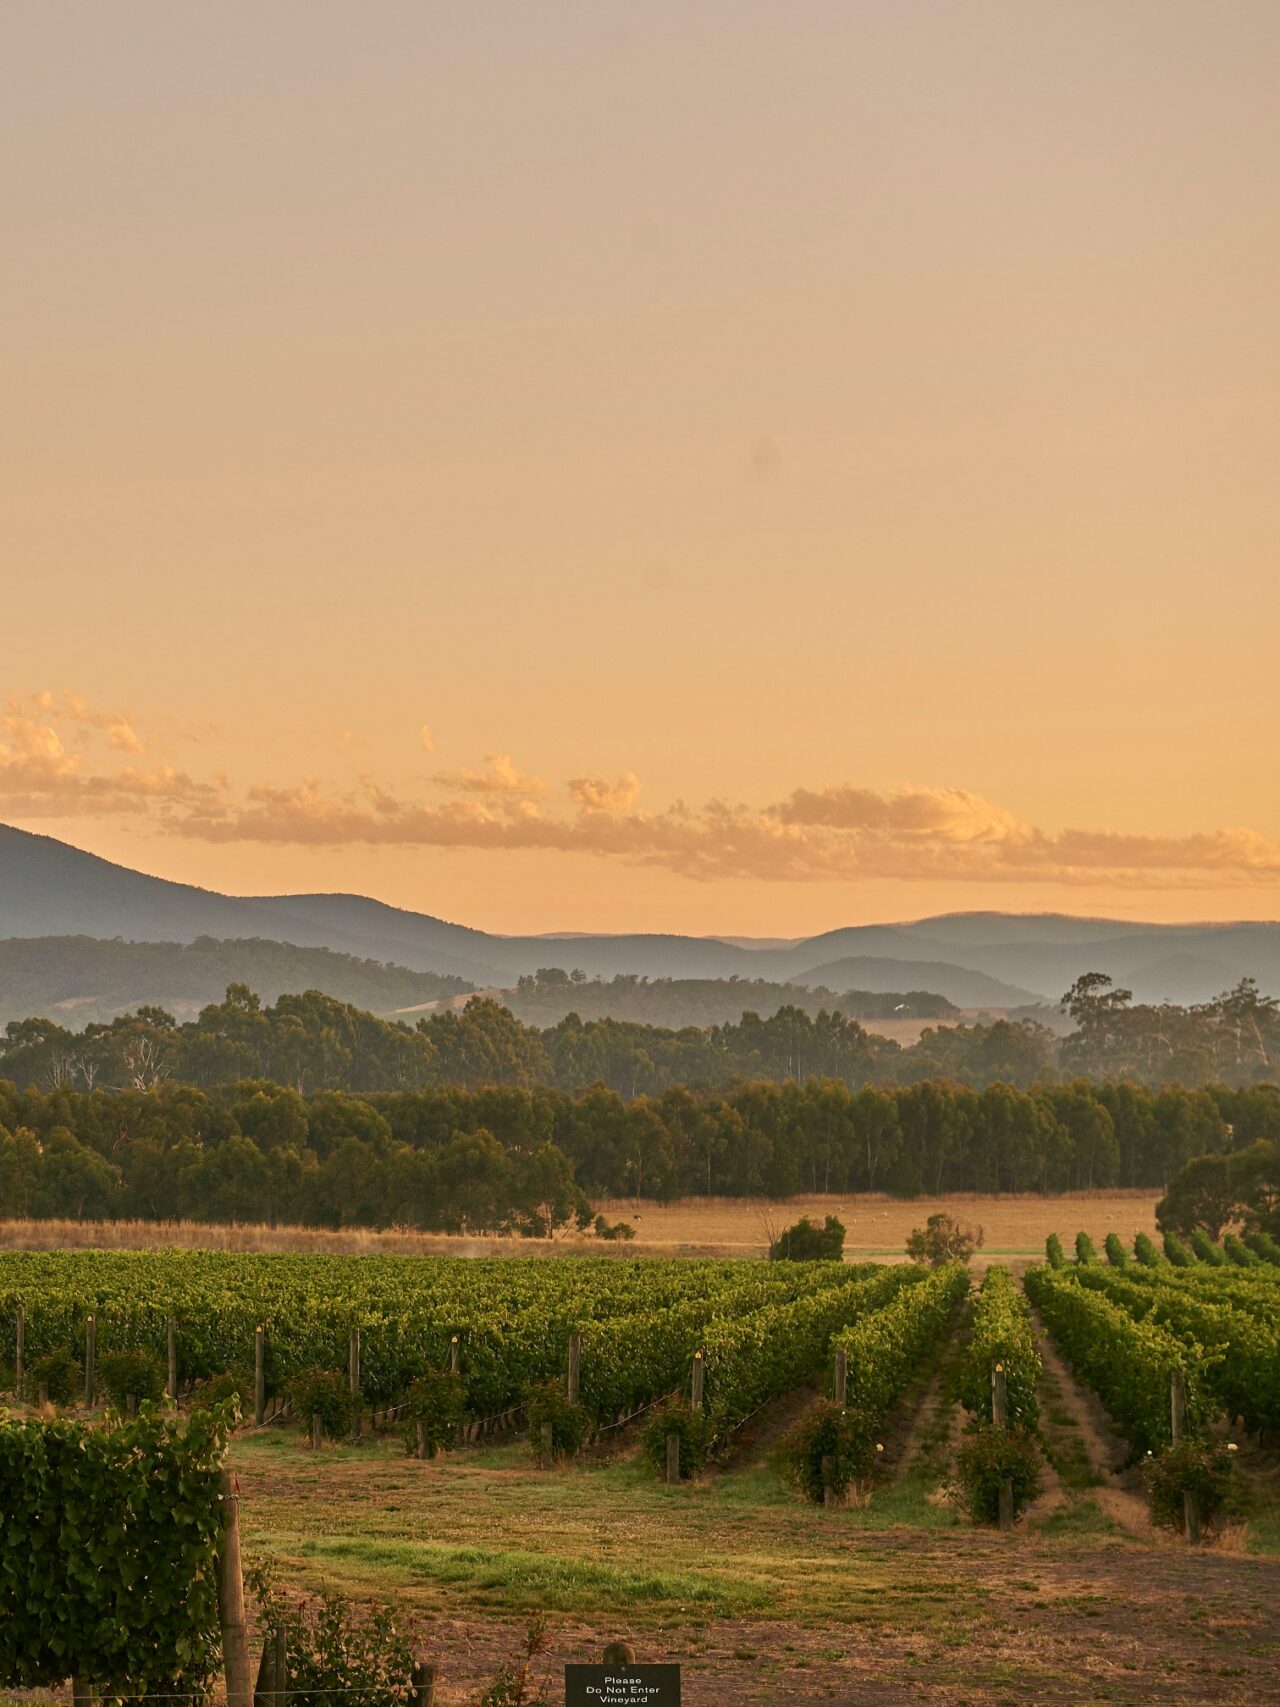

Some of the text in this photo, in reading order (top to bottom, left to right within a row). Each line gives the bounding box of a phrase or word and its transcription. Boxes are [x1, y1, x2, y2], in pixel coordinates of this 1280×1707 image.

[604, 1676, 642, 1684] Please
[586, 1686, 660, 1694] Do Not Enter
[600, 1696, 648, 1705] Vineyard
